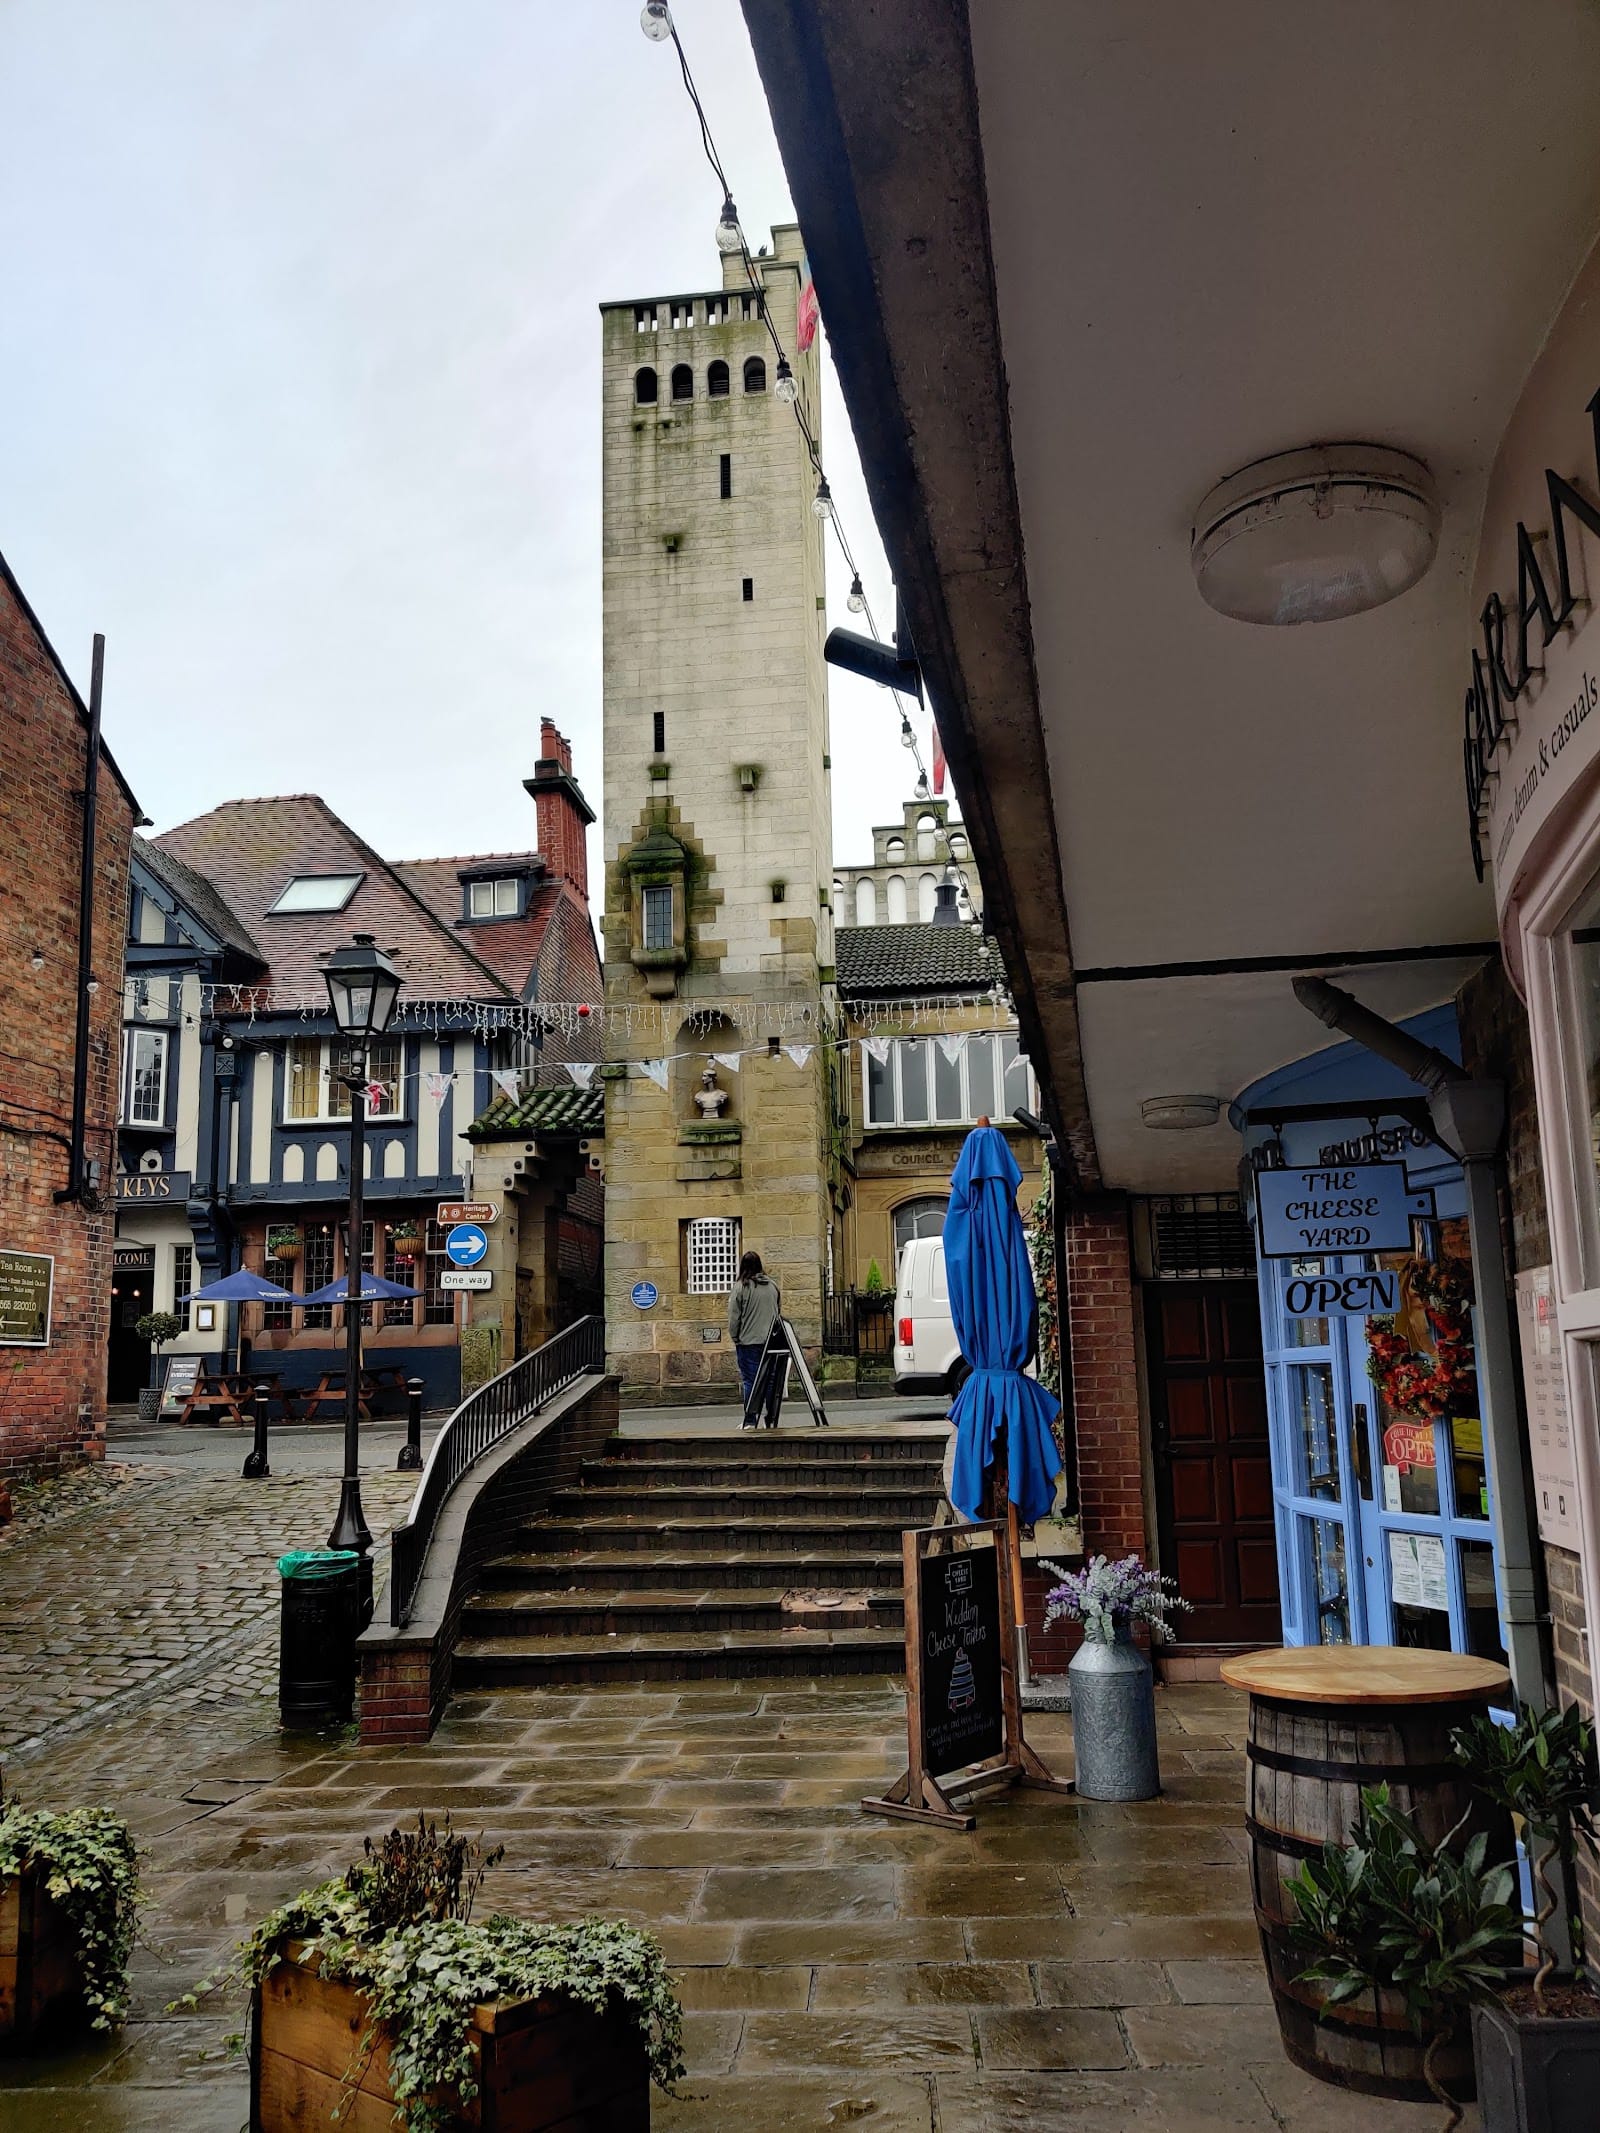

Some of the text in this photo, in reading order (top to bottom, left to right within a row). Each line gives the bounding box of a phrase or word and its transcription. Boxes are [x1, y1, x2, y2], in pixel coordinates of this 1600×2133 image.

[1514, 671, 1599, 825] denim & casuals
[122, 1176, 170, 1198] KEYS
[1301, 1171, 1358, 1192] THE
[463, 1204, 489, 1213] Heritage
[1285, 1198, 1380, 1221] CHEESE
[1299, 1226, 1371, 1248] YARD
[113, 1252, 150, 1266] LCOME
[444, 1275, 488, 1285] One way
[1286, 1274, 1395, 1314] OPEN
